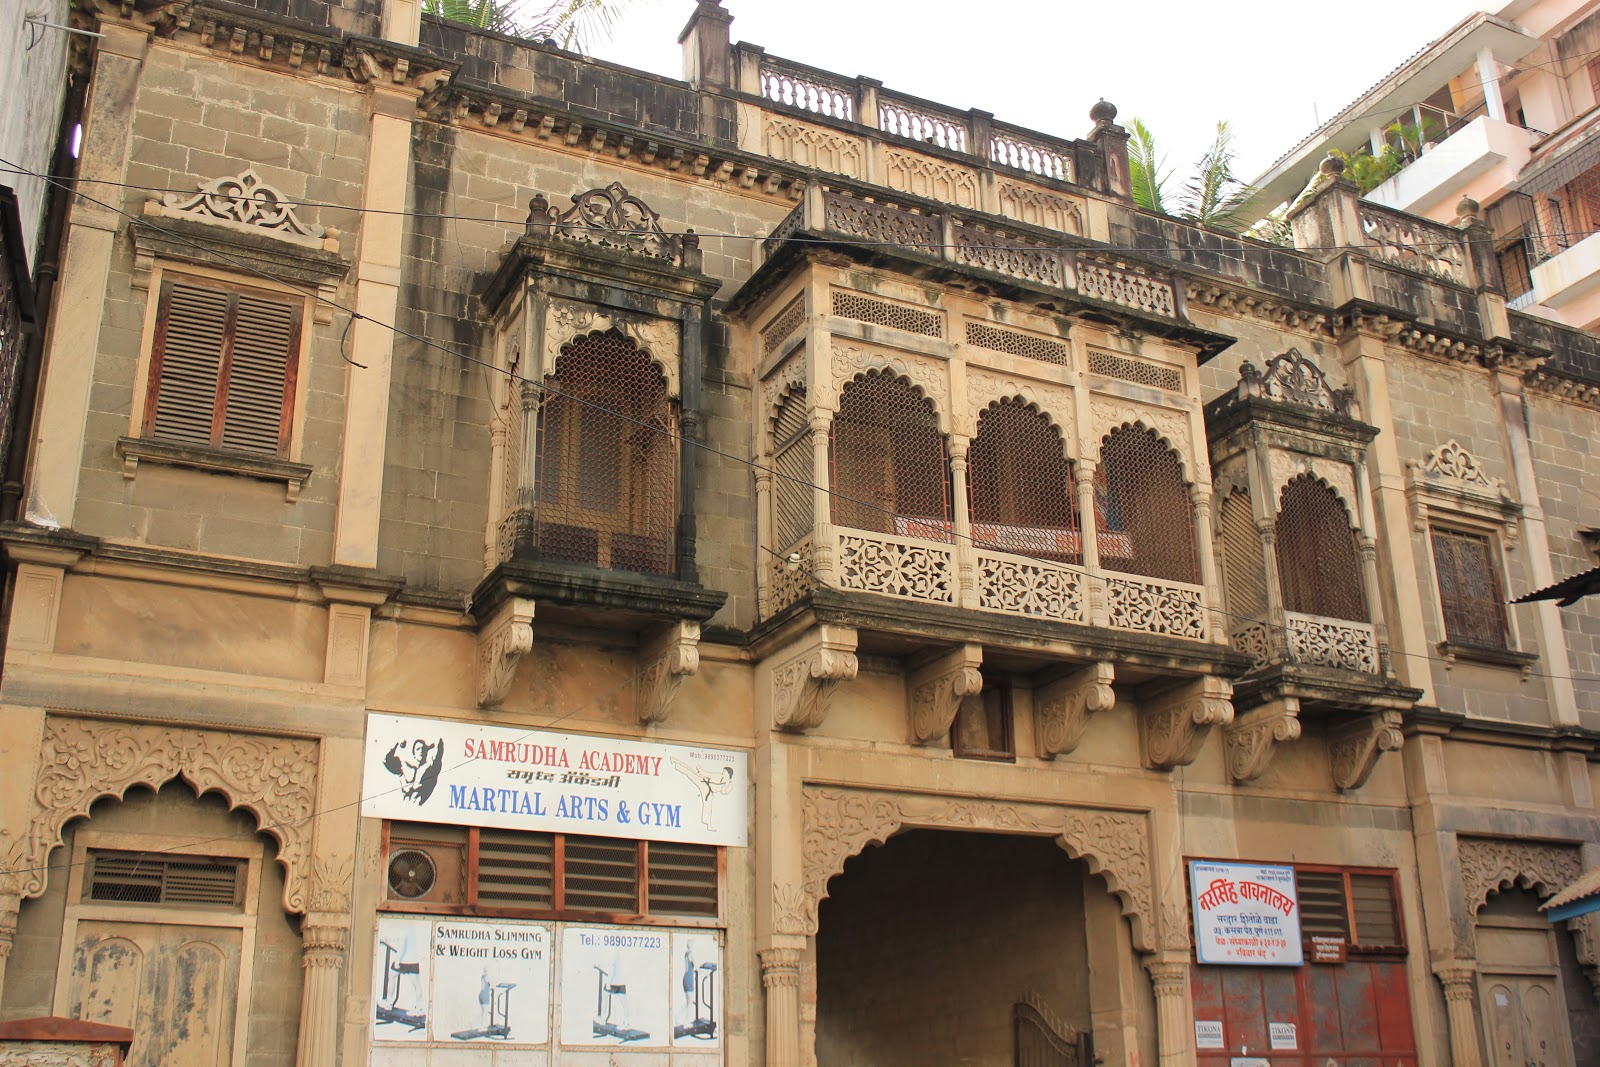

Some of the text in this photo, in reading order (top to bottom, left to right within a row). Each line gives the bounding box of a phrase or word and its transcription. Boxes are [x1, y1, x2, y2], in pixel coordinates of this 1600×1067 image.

[463, 737, 663, 776] SAMRUDHA ACADEMY
[448, 784, 682, 828] MARTIAL ARTS & GYM
[1198, 878, 1295, 917] नरसिंह वाचनालय
[437, 926, 542, 943] SAMRUDHA SLIMMING
[580, 934, 661, 949] Tel.: 9890377223
[435, 944, 542, 960] & WEIGHT LOSS GYM
[1198, 1025, 1221, 1033] TIKONA
